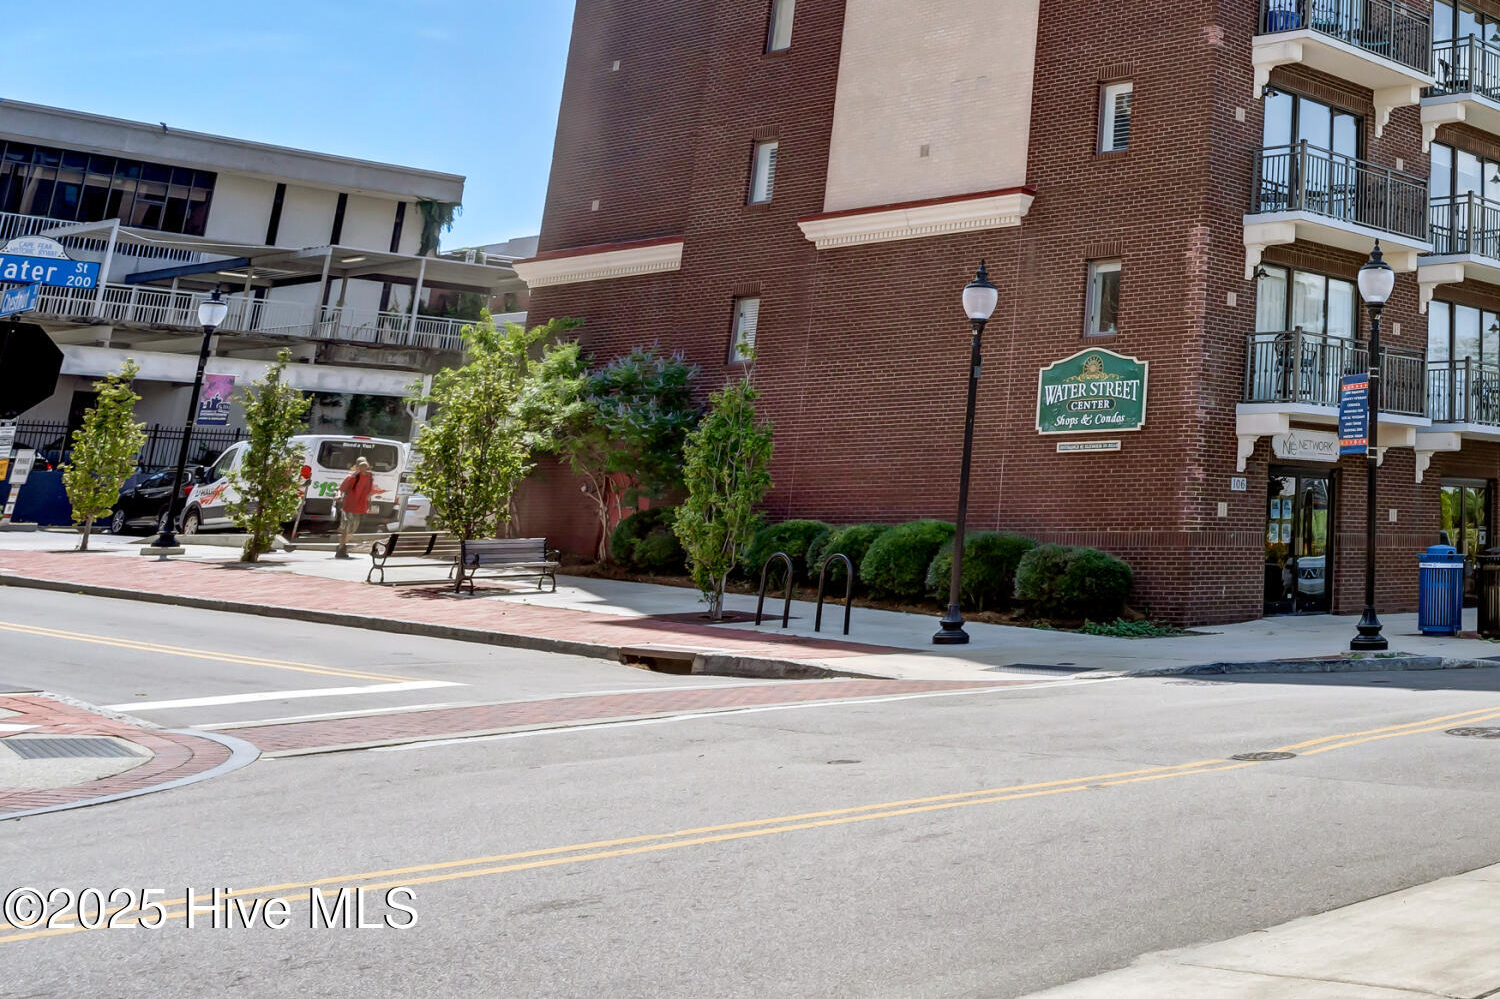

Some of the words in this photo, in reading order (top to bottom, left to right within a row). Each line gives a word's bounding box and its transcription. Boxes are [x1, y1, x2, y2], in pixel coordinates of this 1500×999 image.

[0, 257, 58, 282] ater
[75, 262, 89, 274] St
[66, 275, 92, 288] 200
[1045, 383, 1087, 406] WATER
[1089, 380, 1140, 401] STREET
[1070, 400, 1110, 411] CENTER
[1054, 414, 1079, 429] Shops
[1080, 414, 1093, 426] &
[1094, 411, 1126, 425] Condos
[1298, 440, 1334, 452] NETWORK
[1232, 478, 1246, 488] 106
